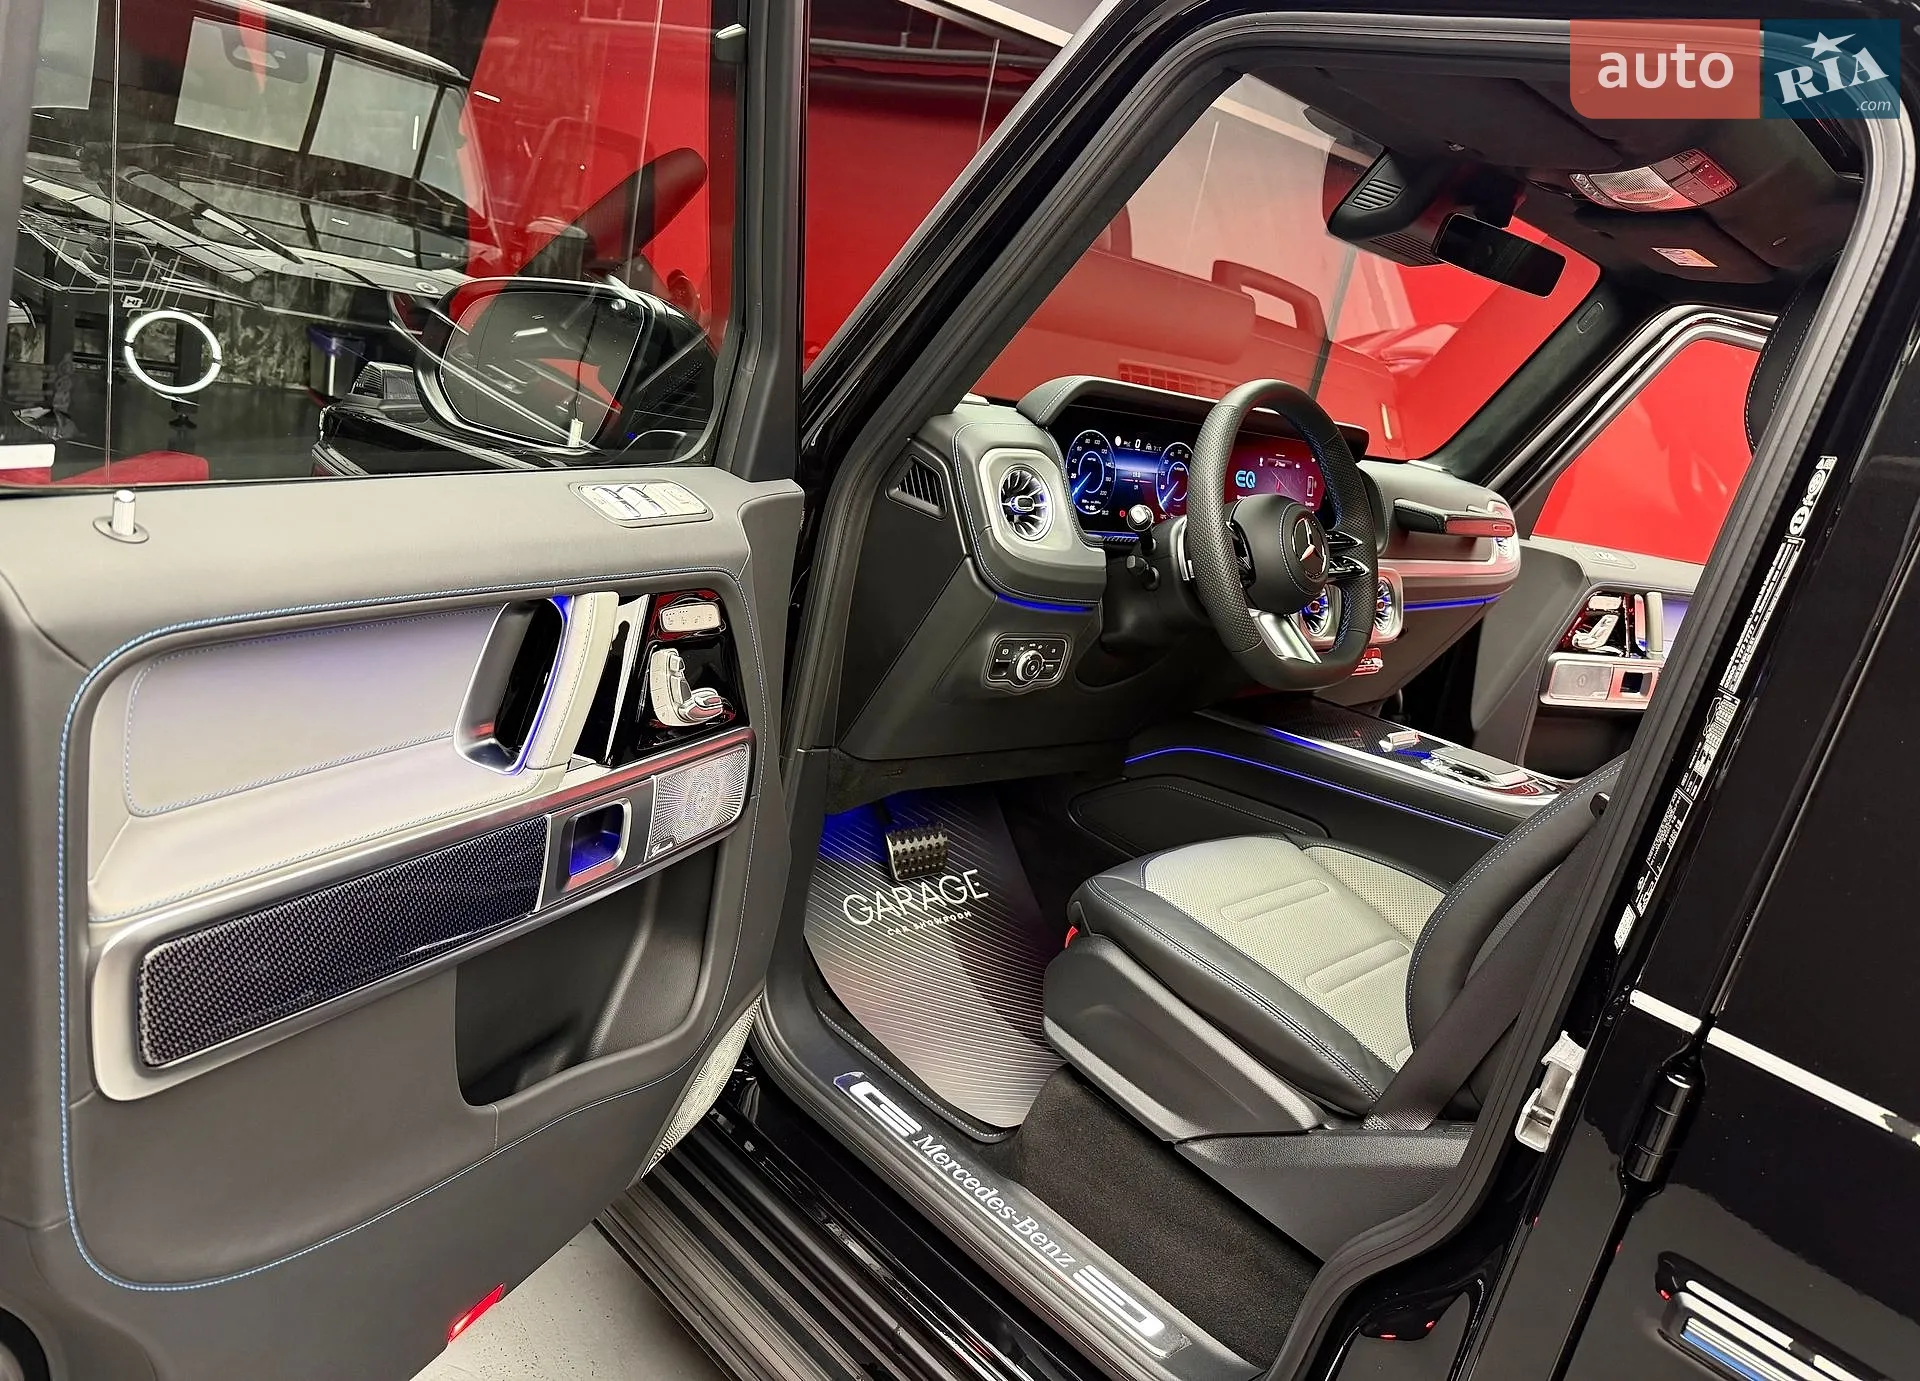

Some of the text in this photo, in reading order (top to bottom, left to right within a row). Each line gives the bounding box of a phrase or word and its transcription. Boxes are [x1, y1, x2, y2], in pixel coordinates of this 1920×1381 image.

[1235, 470, 1256, 489] EQ
[842, 868, 989, 926] GARAGE
[887, 910, 972, 936] CAR SHOWROOM
[913, 1134, 1077, 1268] Mercedes-Benz
